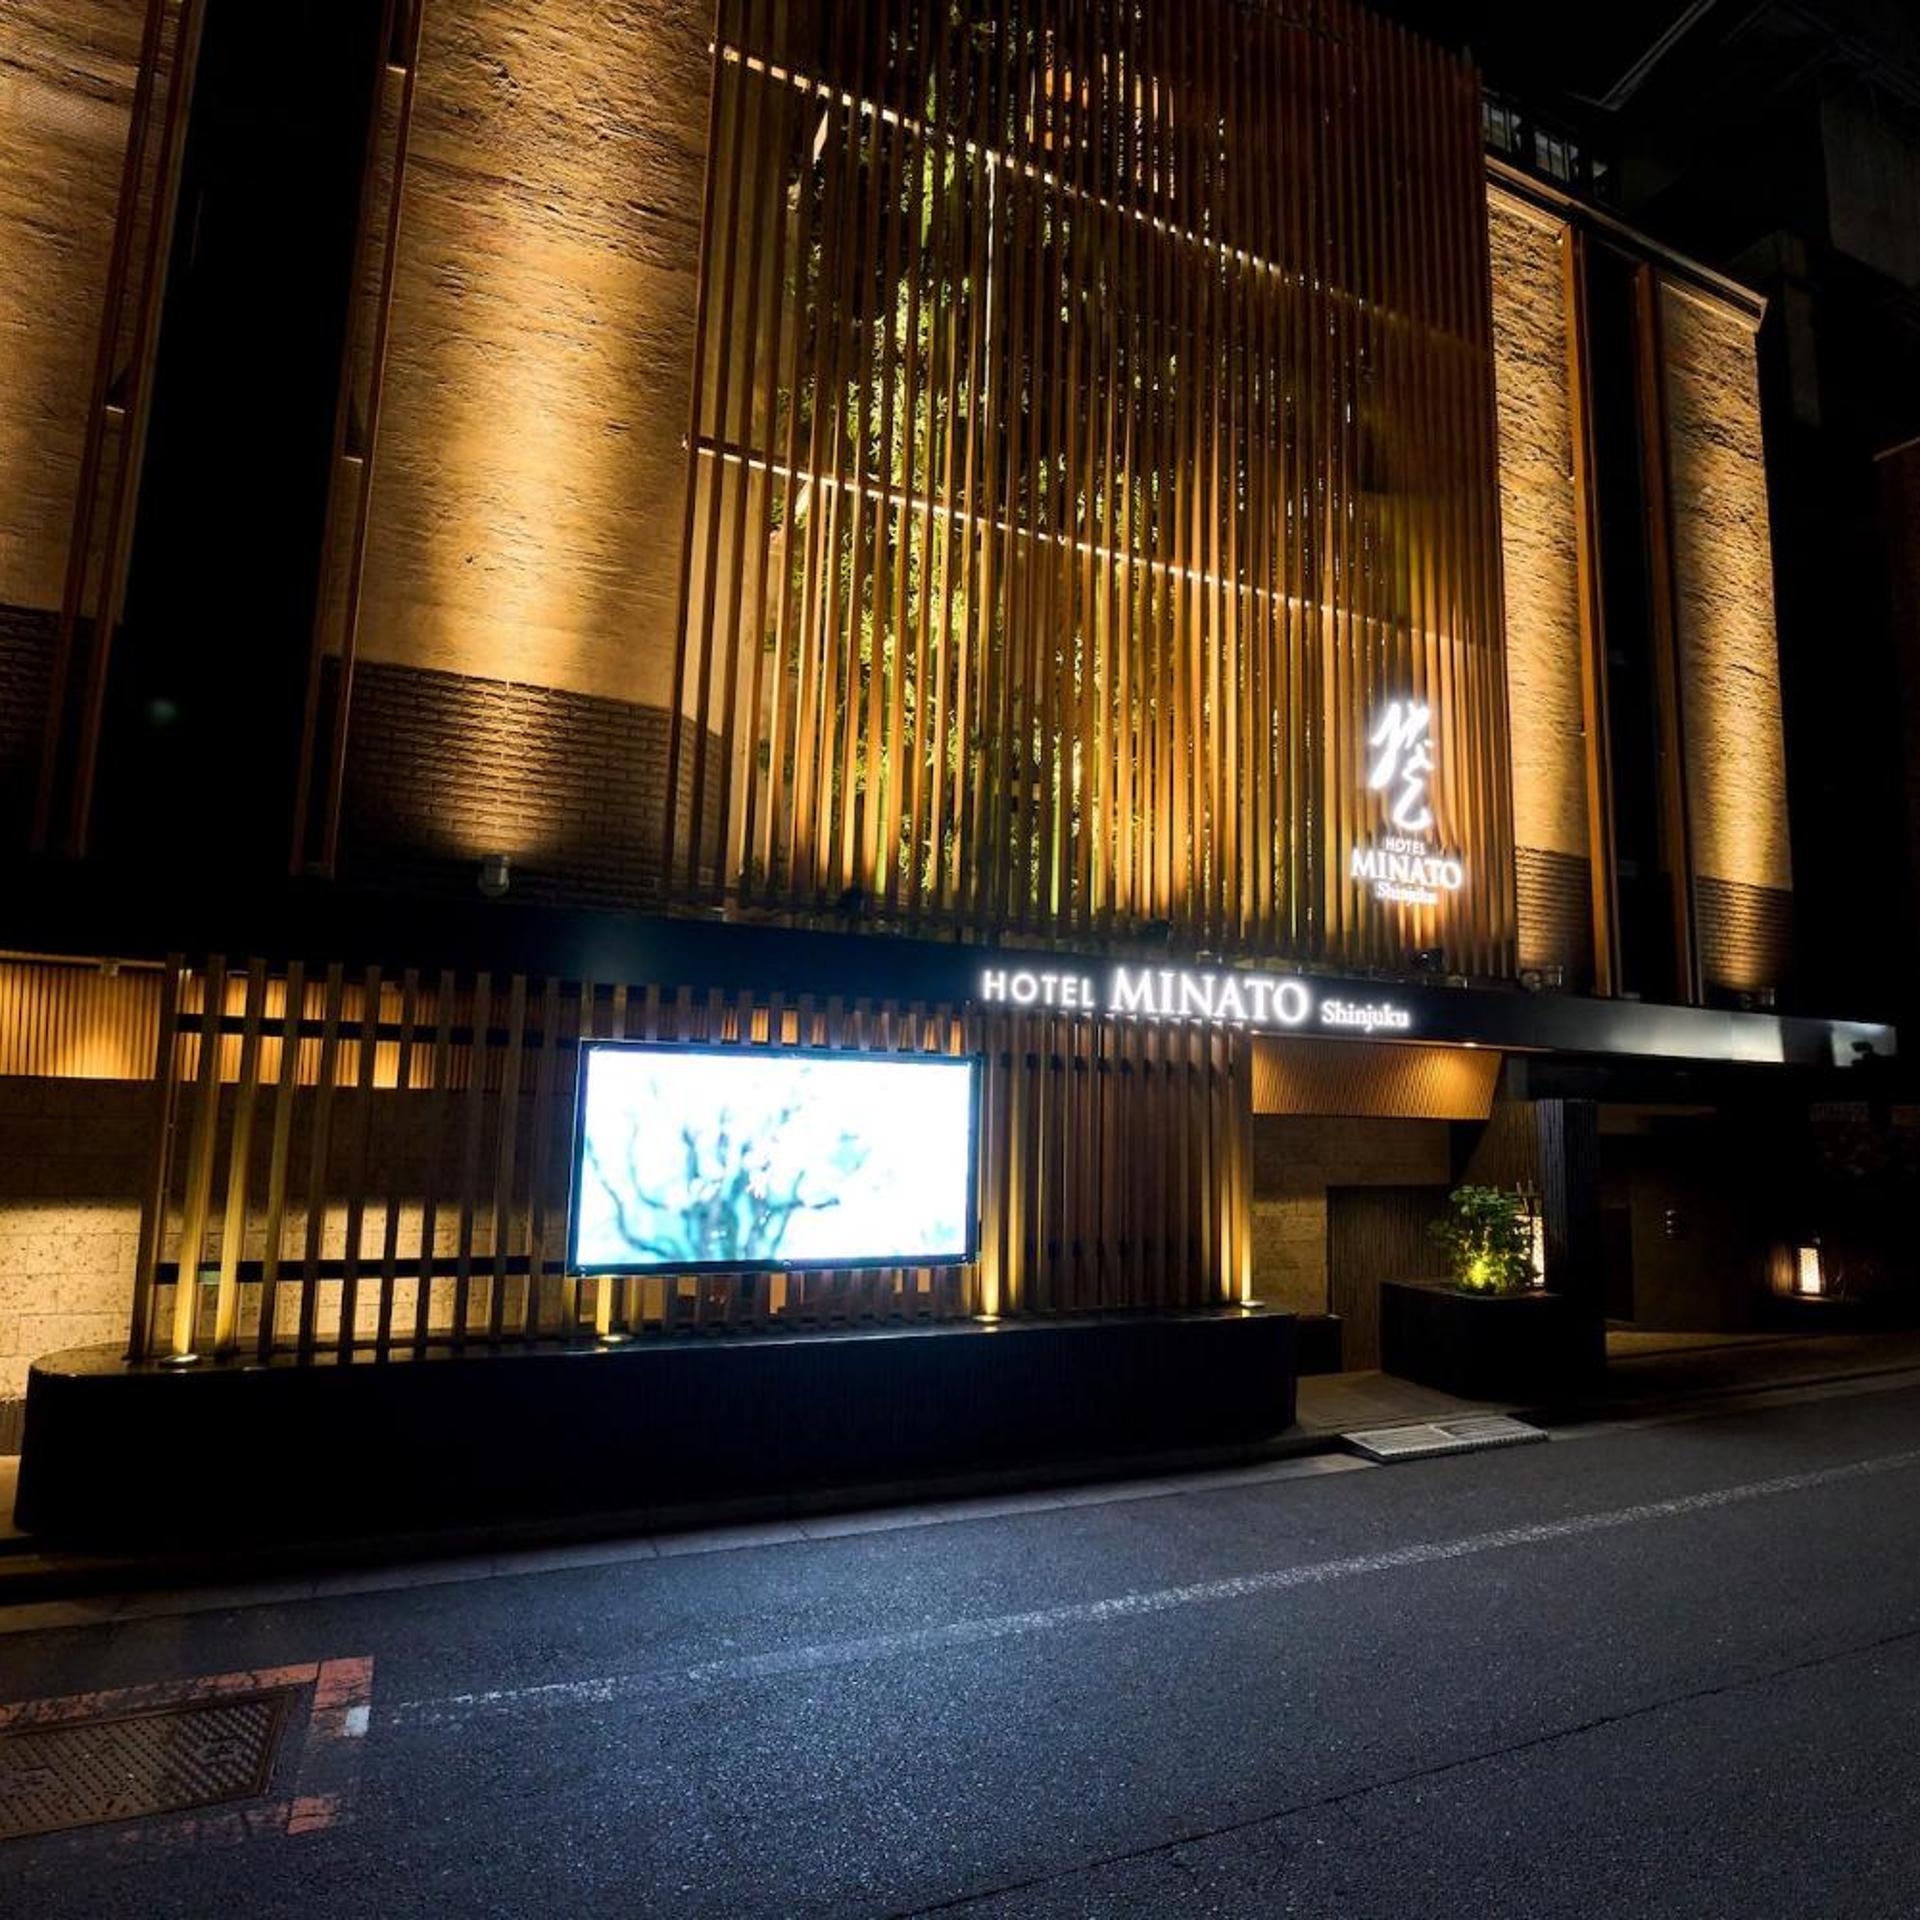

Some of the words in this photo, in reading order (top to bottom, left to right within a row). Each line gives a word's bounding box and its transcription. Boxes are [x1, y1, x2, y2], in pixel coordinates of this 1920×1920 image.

[1385, 837, 1426, 856] HOTEL
[1351, 848, 1462, 889] MINATO
[983, 970, 1095, 1008] HOTEL
[1110, 966, 1309, 1024] MINATO
[1321, 1001, 1410, 1032] Shinjuku
